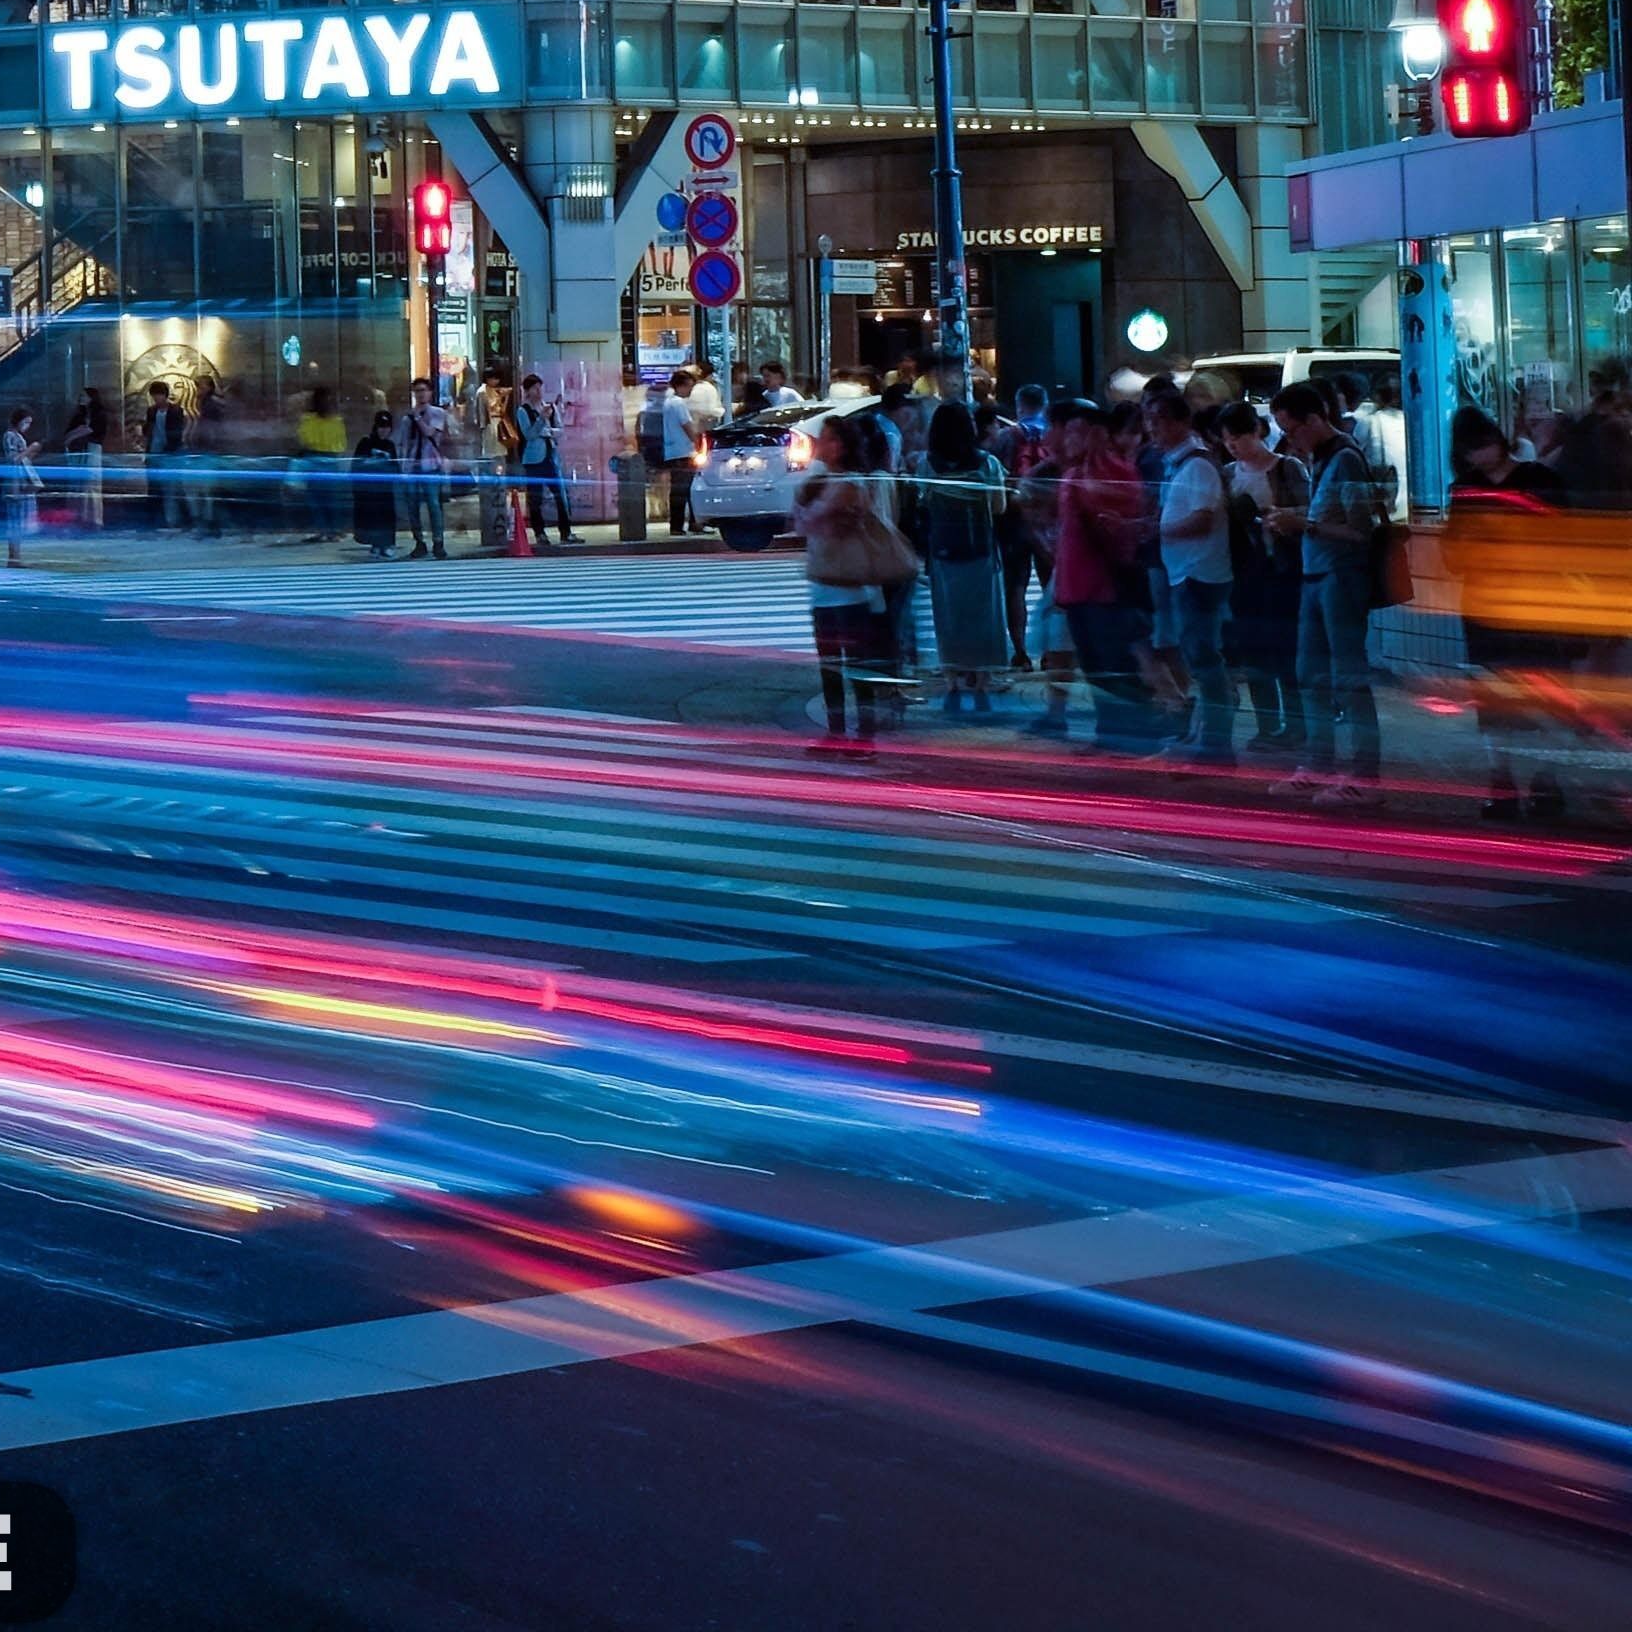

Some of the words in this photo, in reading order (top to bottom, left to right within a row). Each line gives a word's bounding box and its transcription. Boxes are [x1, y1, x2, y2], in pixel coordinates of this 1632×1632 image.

[53, 11, 500, 110] TSUTAYA
[898, 229, 1016, 248] STAUCKS
[1020, 226, 1102, 243] COFFEE
